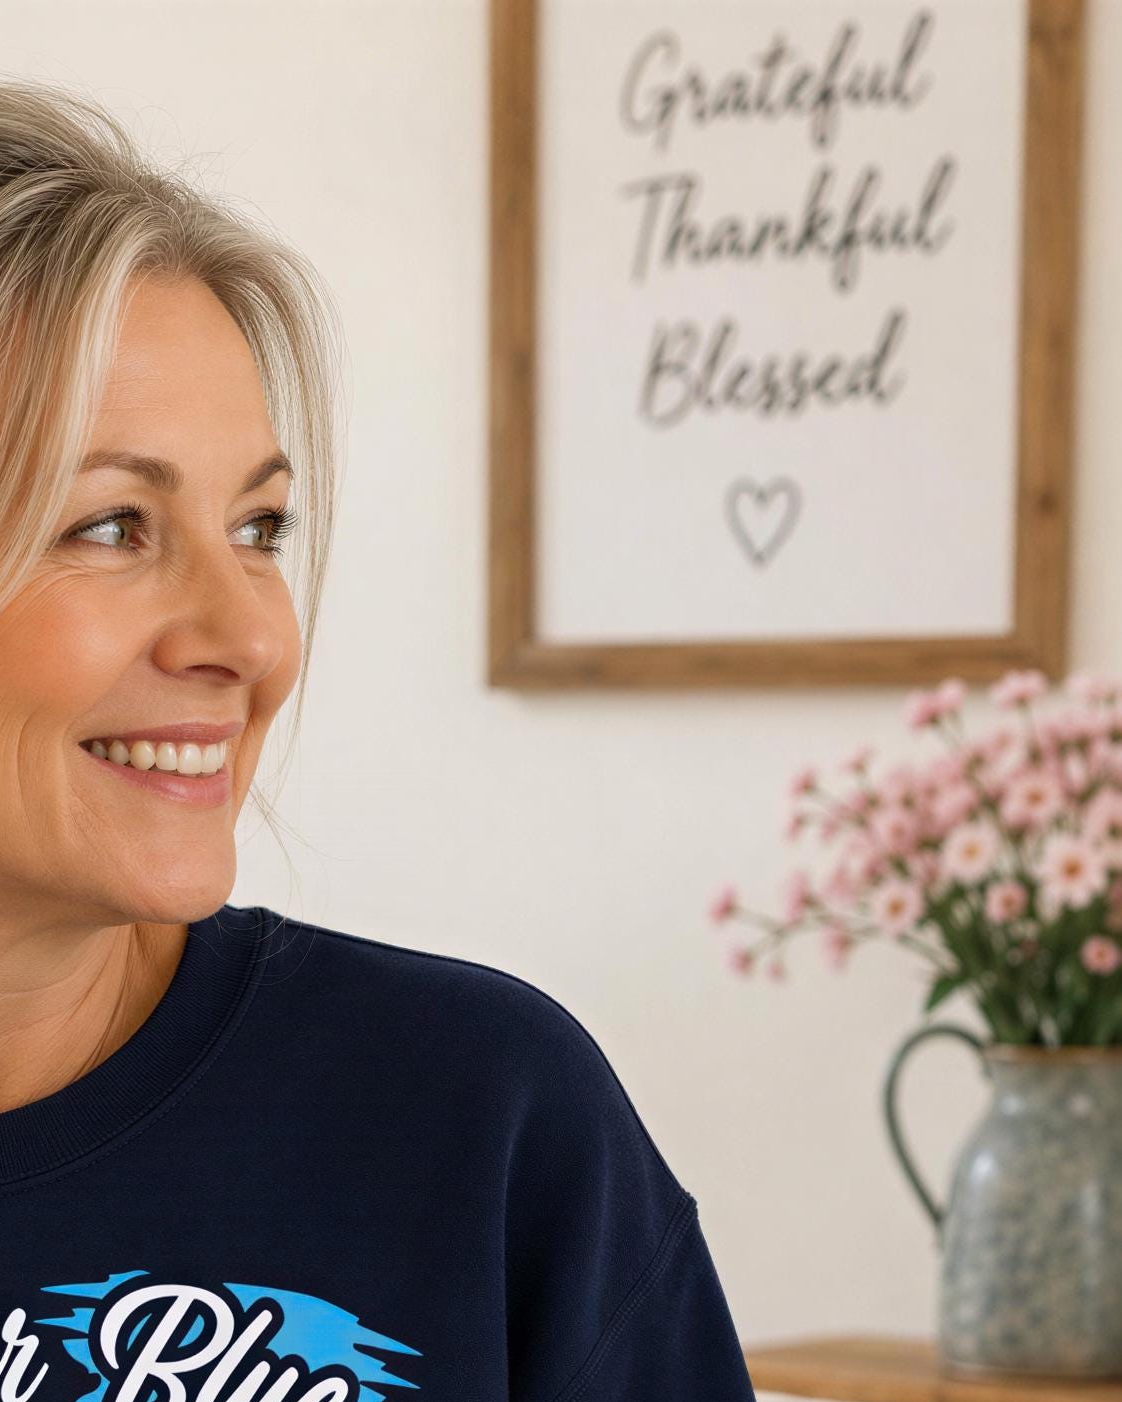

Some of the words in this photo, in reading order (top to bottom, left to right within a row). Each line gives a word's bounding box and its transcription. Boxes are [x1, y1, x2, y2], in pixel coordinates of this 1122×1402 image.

[619, 8, 934, 152] Grateful
[620, 153, 959, 295] Thankful
[637, 306, 907, 430] Blessed
